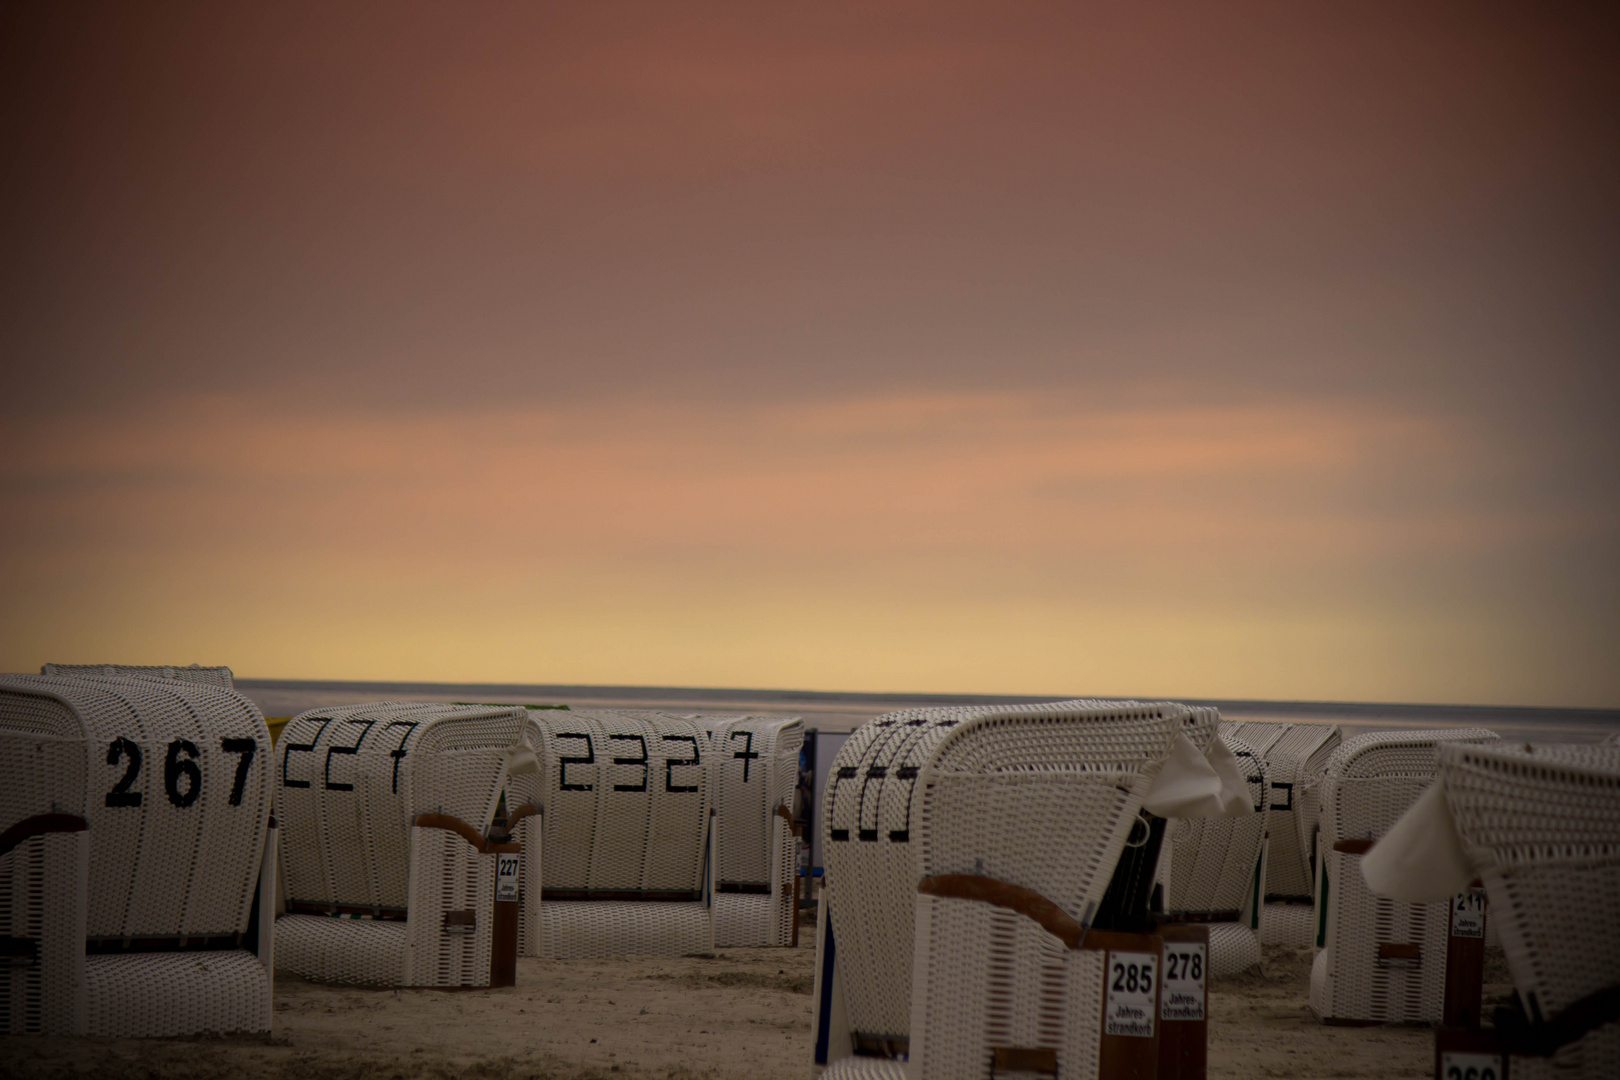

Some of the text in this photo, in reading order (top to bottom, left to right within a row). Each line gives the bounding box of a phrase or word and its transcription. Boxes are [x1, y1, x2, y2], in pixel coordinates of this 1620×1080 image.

[283, 717, 419, 795] 227
[556, 733, 700, 792] 232
[105, 736, 256, 807] 267
[500, 859, 518, 876] 227
[1113, 964, 1152, 993] 285
[1167, 953, 1202, 980] 278
[1116, 1006, 1145, 1019] Jahres-
